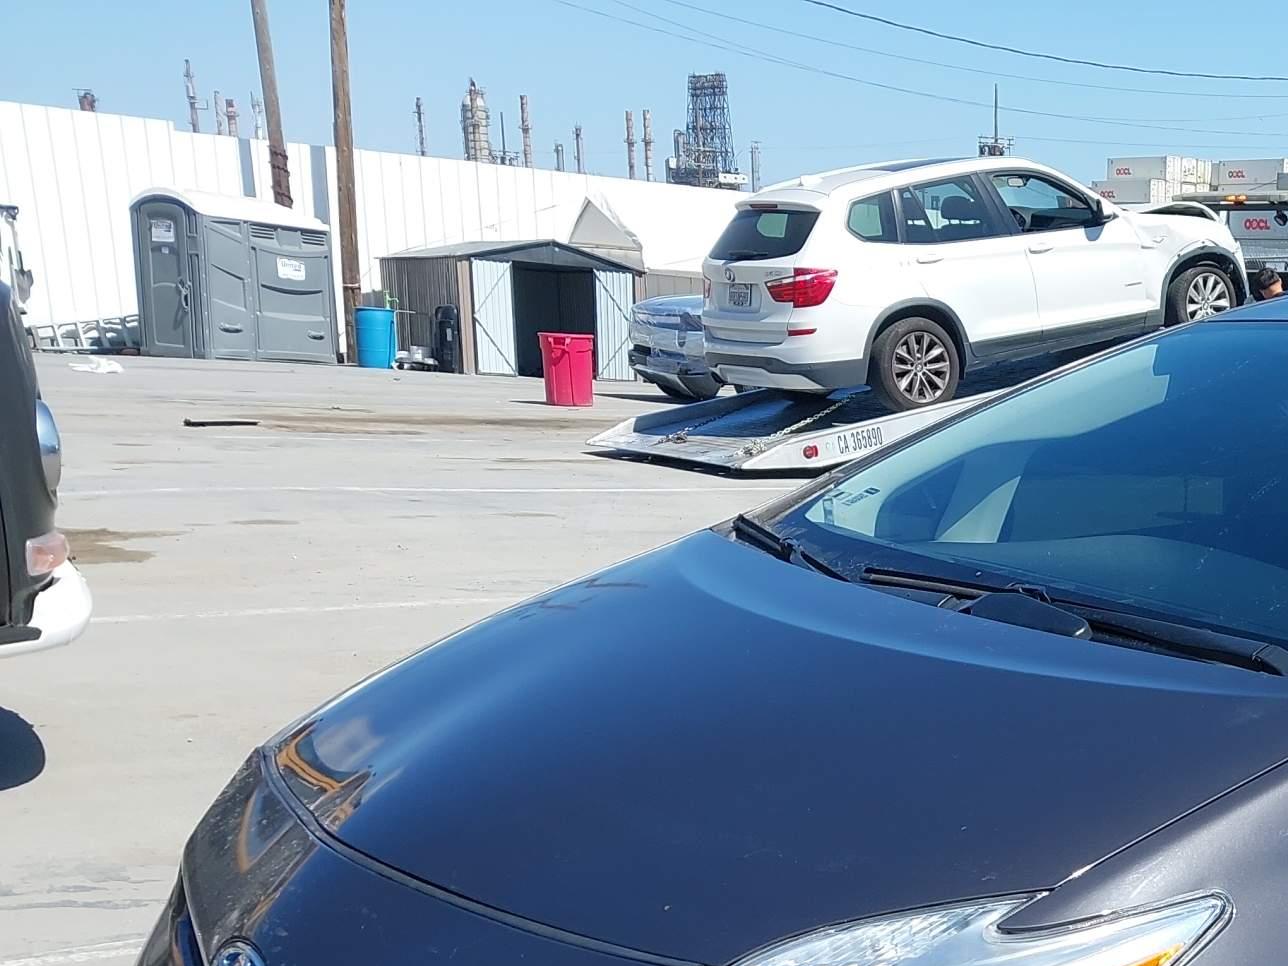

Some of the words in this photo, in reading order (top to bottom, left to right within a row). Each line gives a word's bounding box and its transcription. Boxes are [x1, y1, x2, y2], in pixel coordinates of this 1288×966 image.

[1115, 167, 1132, 176] OOCL
[1228, 170, 1245, 179] OOCL
[1099, 190, 1116, 199] OOCL
[1244, 218, 1271, 230] OOCL
[837, 434, 850, 454] CA
[850, 426, 883, 452] 365890
